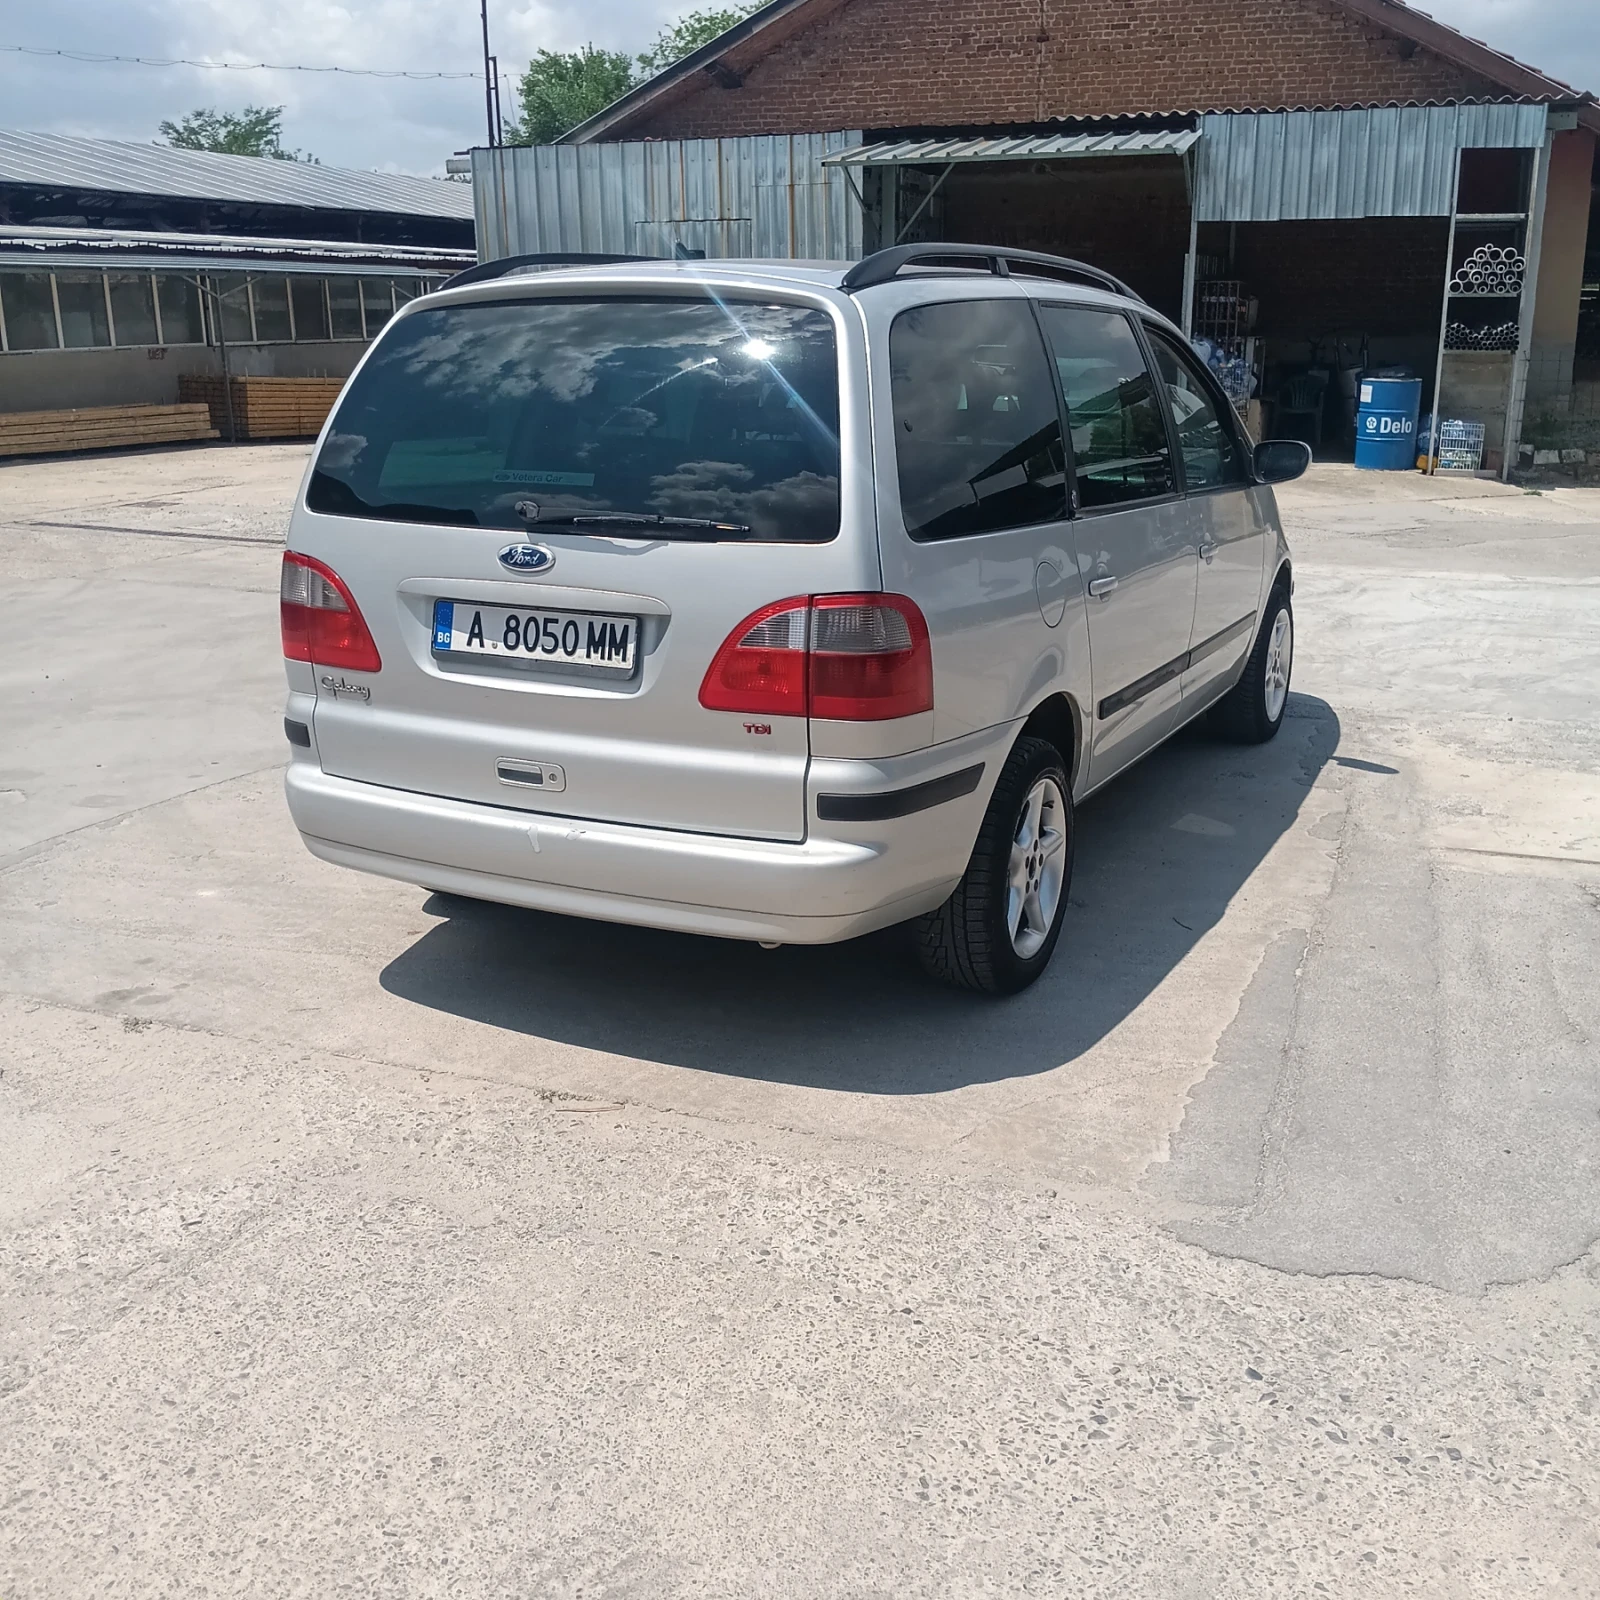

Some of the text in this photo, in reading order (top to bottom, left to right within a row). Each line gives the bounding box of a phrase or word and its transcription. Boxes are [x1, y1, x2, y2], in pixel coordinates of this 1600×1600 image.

[1380, 417, 1412, 434] Delo
[507, 547, 540, 565] Ford
[437, 632, 451, 644] BG
[466, 611, 630, 663] A 8050 MM
